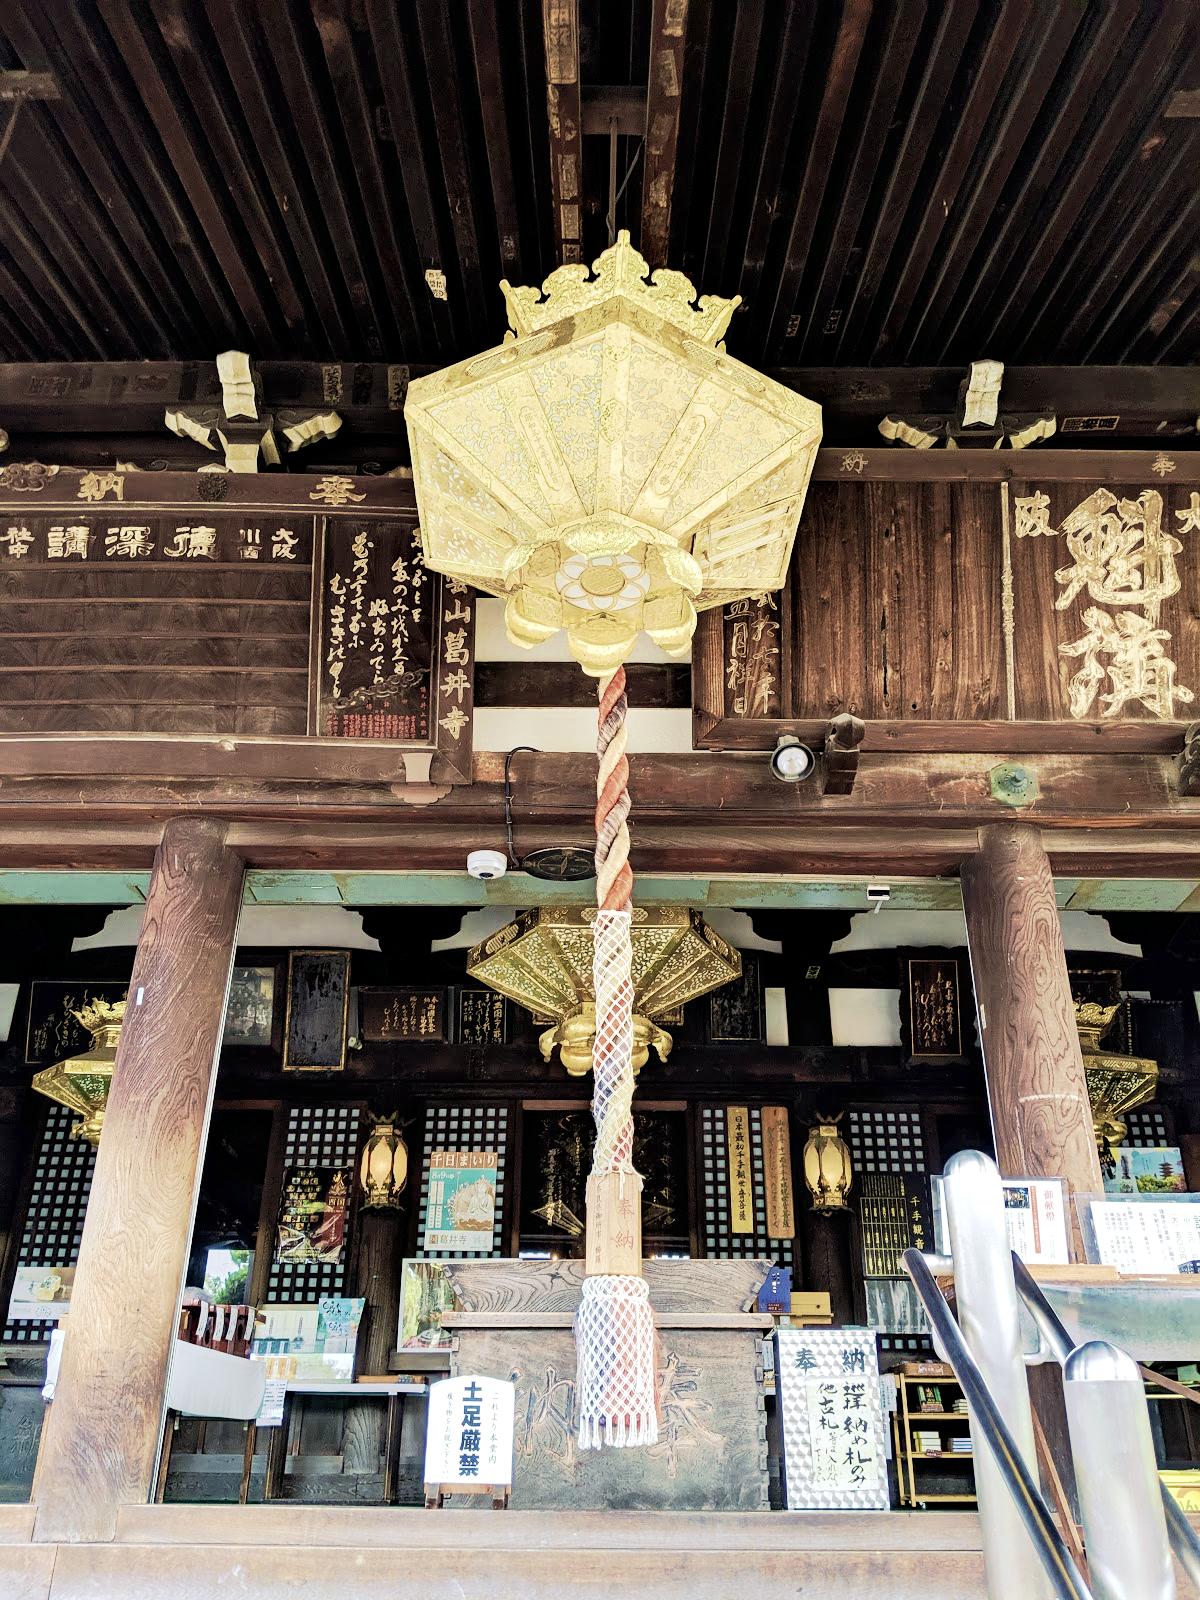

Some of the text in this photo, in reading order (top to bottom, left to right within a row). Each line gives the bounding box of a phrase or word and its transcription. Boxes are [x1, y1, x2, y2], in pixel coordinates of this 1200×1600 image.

[431, 1153, 496, 1167] 千日まいり
[614, 1197, 635, 1250] 奉納
[909, 1196, 925, 1250] 千手観音
[795, 1347, 865, 1374] 奉納
[459, 1381, 483, 1477] 土足厳禁
